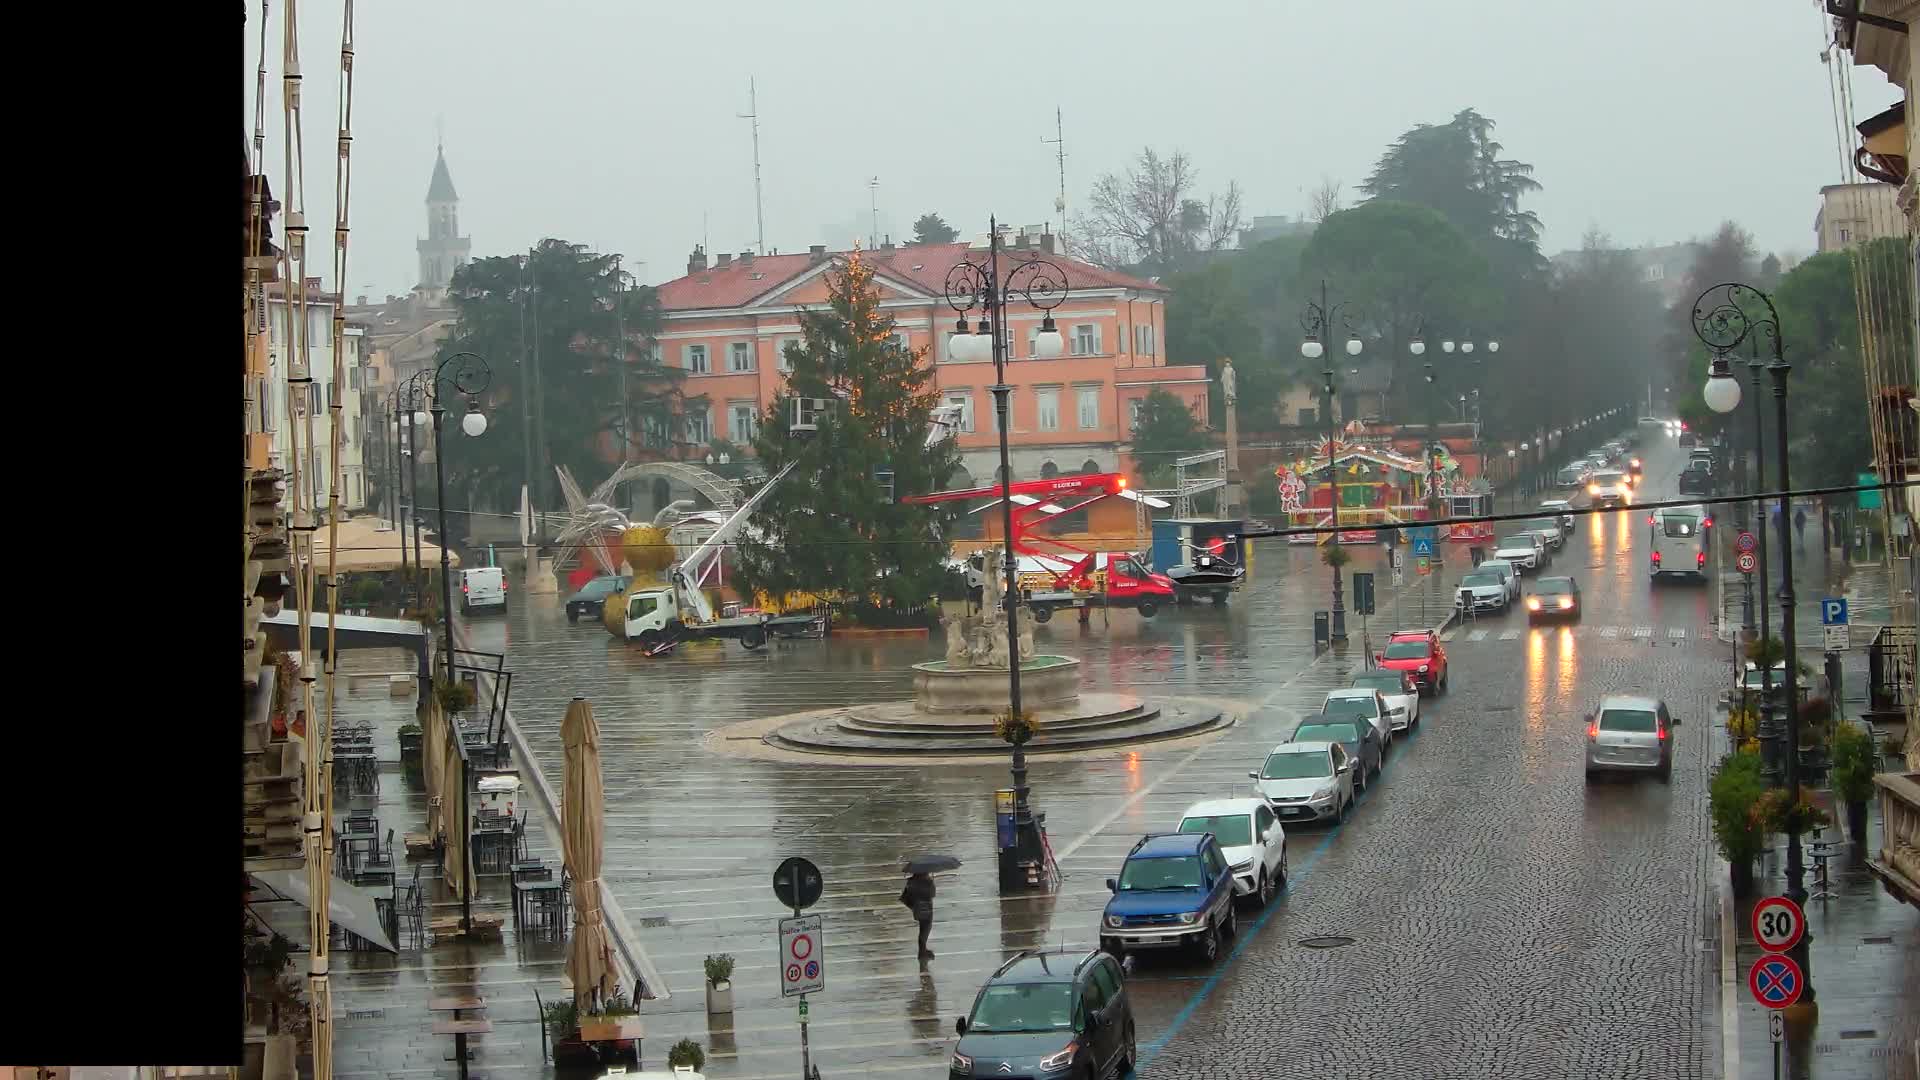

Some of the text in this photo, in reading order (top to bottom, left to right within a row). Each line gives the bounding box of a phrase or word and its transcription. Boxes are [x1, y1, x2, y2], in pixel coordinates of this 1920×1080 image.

[1742, 557, 1752, 567] 20
[1827, 602, 1841, 622] P
[1762, 911, 1791, 937] 30
